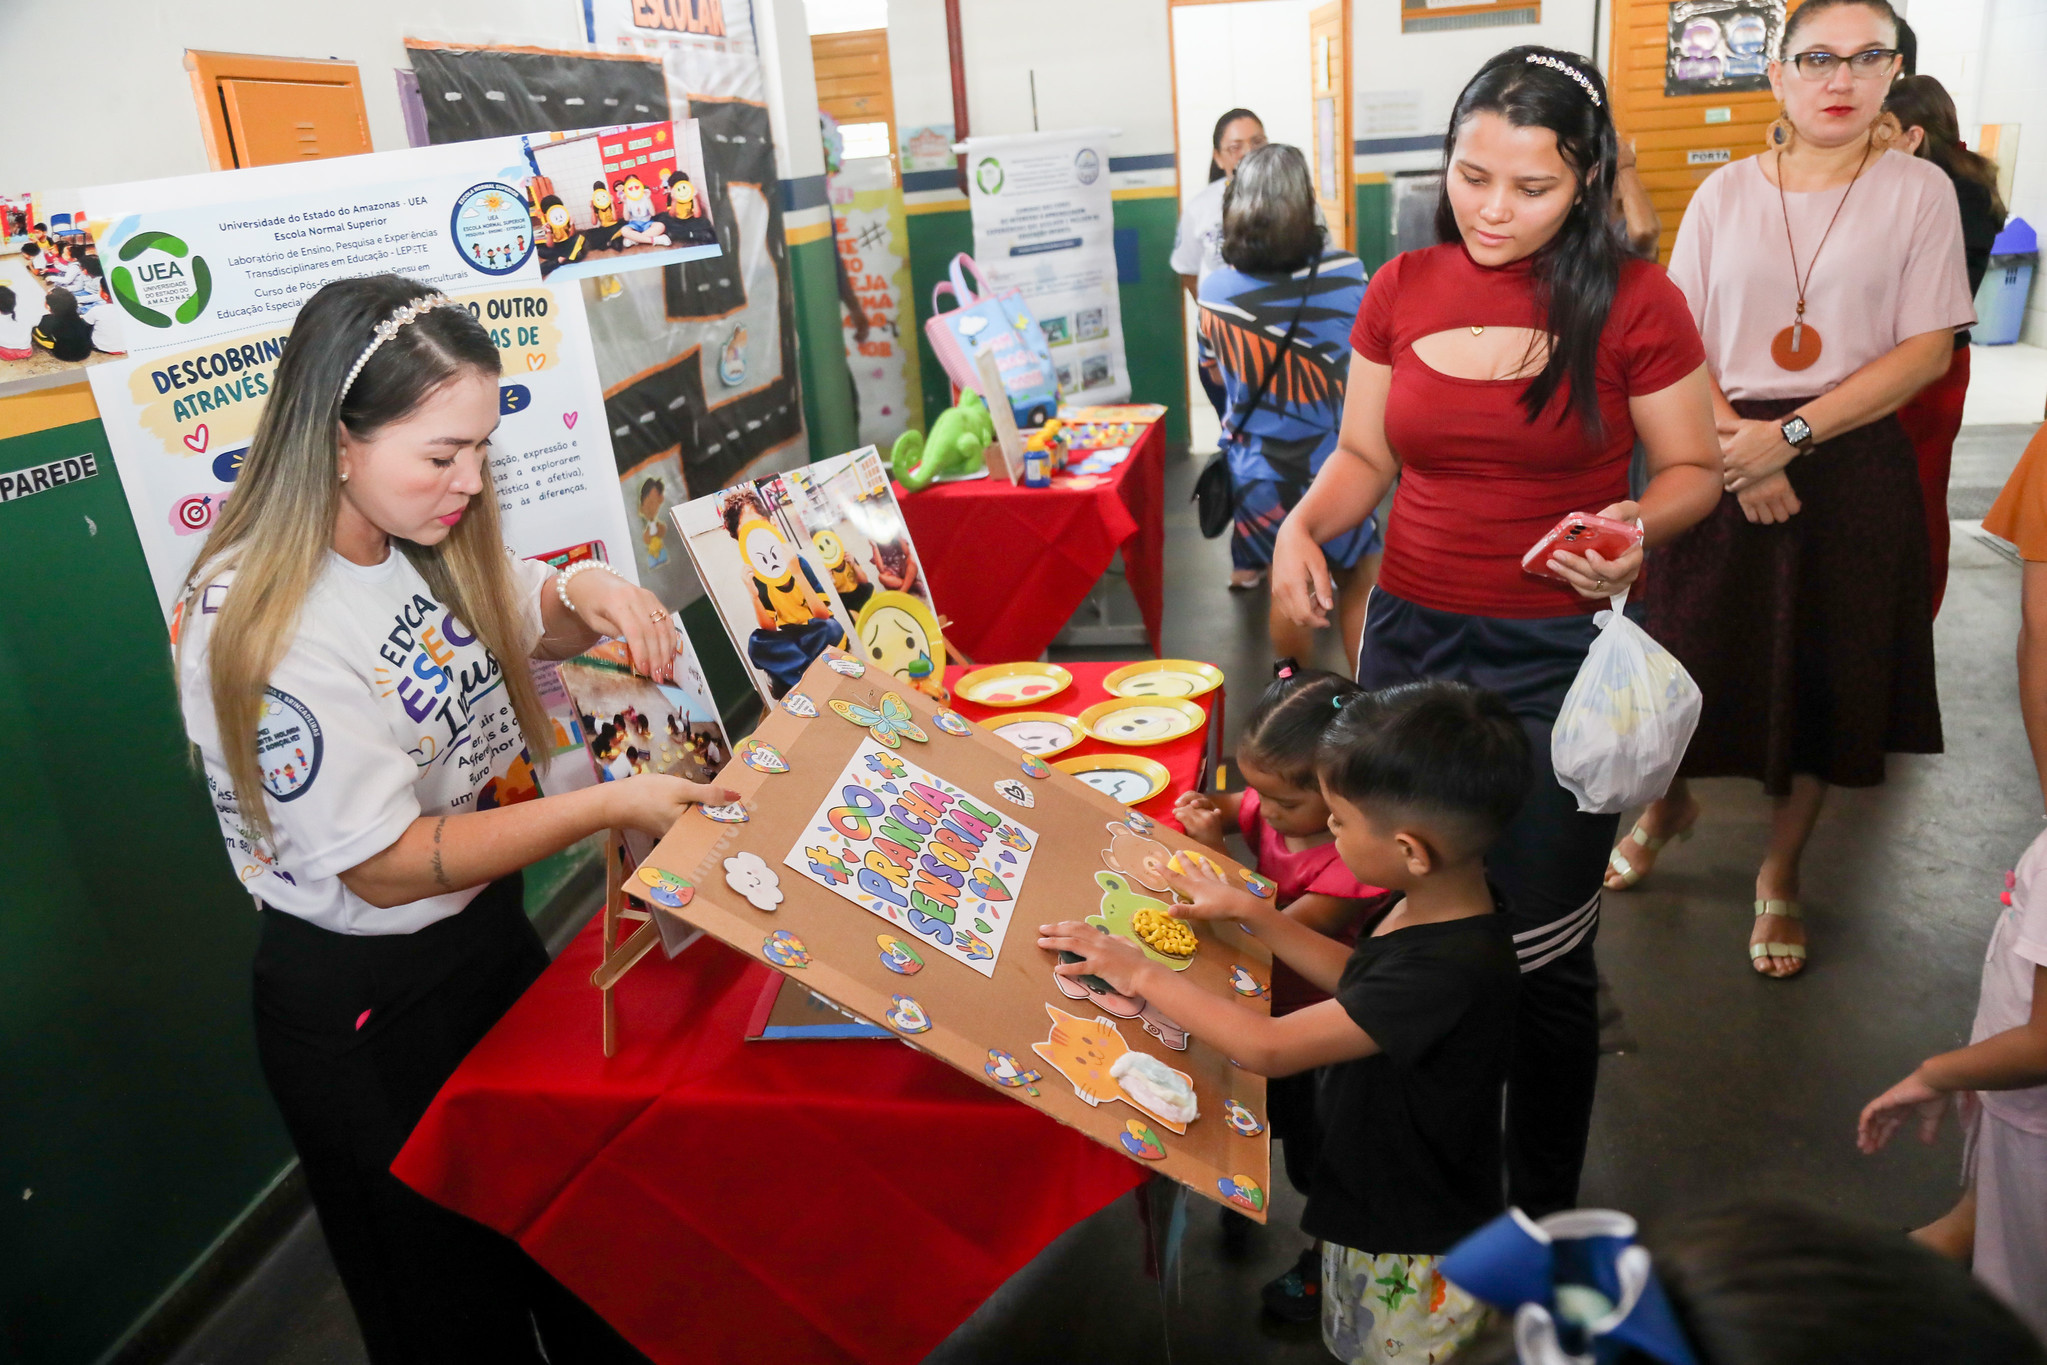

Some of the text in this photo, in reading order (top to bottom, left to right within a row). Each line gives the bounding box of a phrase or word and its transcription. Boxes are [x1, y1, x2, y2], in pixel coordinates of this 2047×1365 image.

[1692, 152, 1730, 161] PORTA
[218, 217, 286, 231] Universidade
[288, 214, 300, 222] do
[303, 210, 335, 221] Estado
[338, 207, 350, 215] do
[353, 201, 400, 213] Amazonas
[408, 196, 428, 206] UEA
[503, 218, 525, 226] SUPERIOR
[274, 217, 387, 241] Escola Normal Superior
[228, 251, 285, 266] Laboratório
[287, 249, 299, 258] de
[301, 245, 334, 256] Ensino,
[336, 238, 375, 250] Pesquisa
[245, 260, 329, 279] Transdisciplinares
[331, 258, 345, 267] em
[347, 250, 388, 264] Educação
[138, 261, 184, 282] UEA
[254, 287, 283, 297] Curso
[286, 285, 298, 294] de
[391, 264, 416, 274] Sensu
[418, 263, 430, 271] em
[143, 281, 187, 292] UNIVERSIDADE
[148, 294, 190, 305] AMAZONAS
[216, 271, 468, 319] Educação Especial terculturais
[151, 336, 292, 395] DESCOBRIN
[487, 297, 548, 319] OUTRO
[173, 326, 540, 422] ATRAVÉS AS DE
[523, 441, 568, 459] expressão
[0, 453, 97, 501] PAREDE
[493, 473, 508, 484] ças
[531, 455, 581, 472] explorarem
[547, 467, 584, 483] afetiva),
[521, 497, 530, 505] às
[284, 696, 320, 738] BRINCADEIRAS
[500, 706, 508, 715] e
[500, 722, 509, 733] é
[451, 792, 473, 807] um
[857, 781, 955, 908] PRANCHA
[907, 799, 1002, 945] SENSORIAL
